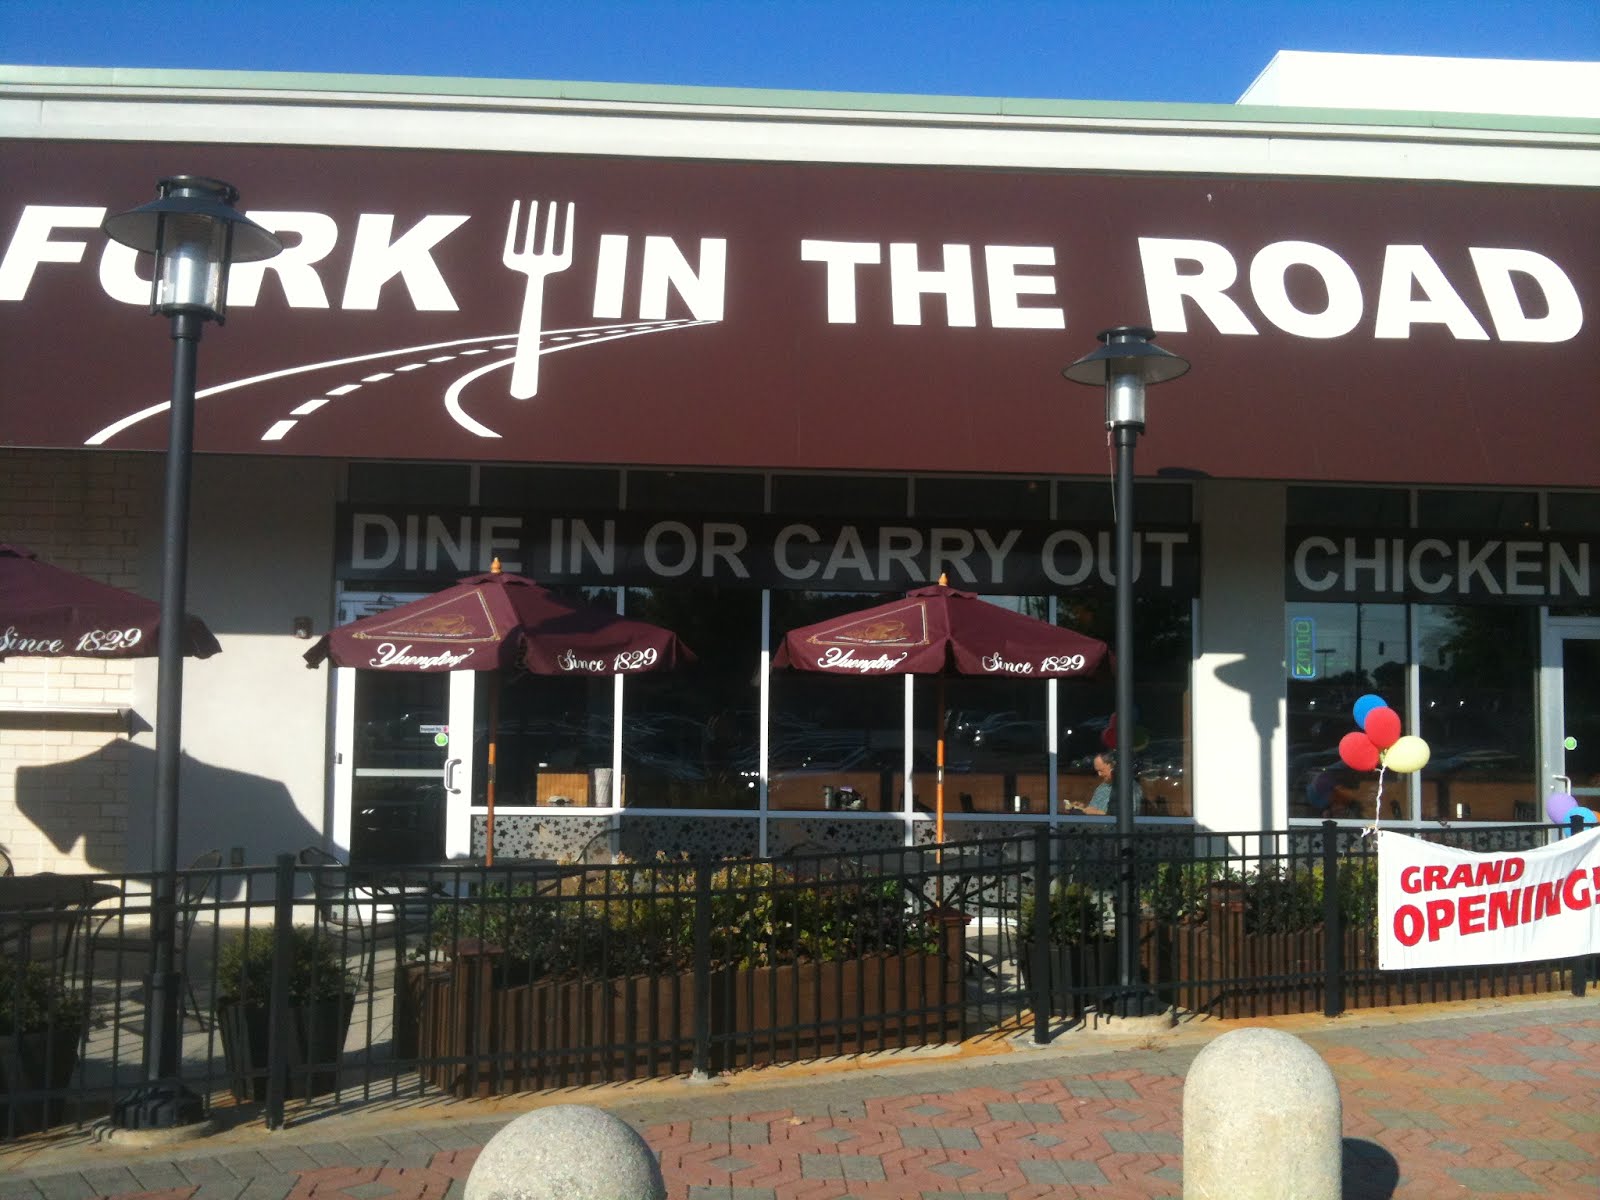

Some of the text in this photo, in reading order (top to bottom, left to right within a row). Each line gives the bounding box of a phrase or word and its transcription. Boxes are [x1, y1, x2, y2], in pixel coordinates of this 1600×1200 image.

[592, 233, 727, 321] IN
[800, 238, 1066, 330] THE
[1137, 236, 1584, 343] ROAD
[351, 512, 1189, 588] DINE IN OR CARRY OUT
[1292, 536, 1590, 597] CHICKEN
[75, 628, 142, 652] 1829
[369, 642, 475, 670] Yuengling
[1296, 621, 1312, 675] OPEN
[557, 647, 658, 672] Since 1829
[817, 647, 908, 673] Yuengling
[981, 651, 1086, 674] Since 1829
[1400, 856, 1526, 894] GRAND
[1393, 866, 1600, 947] OPENING!
